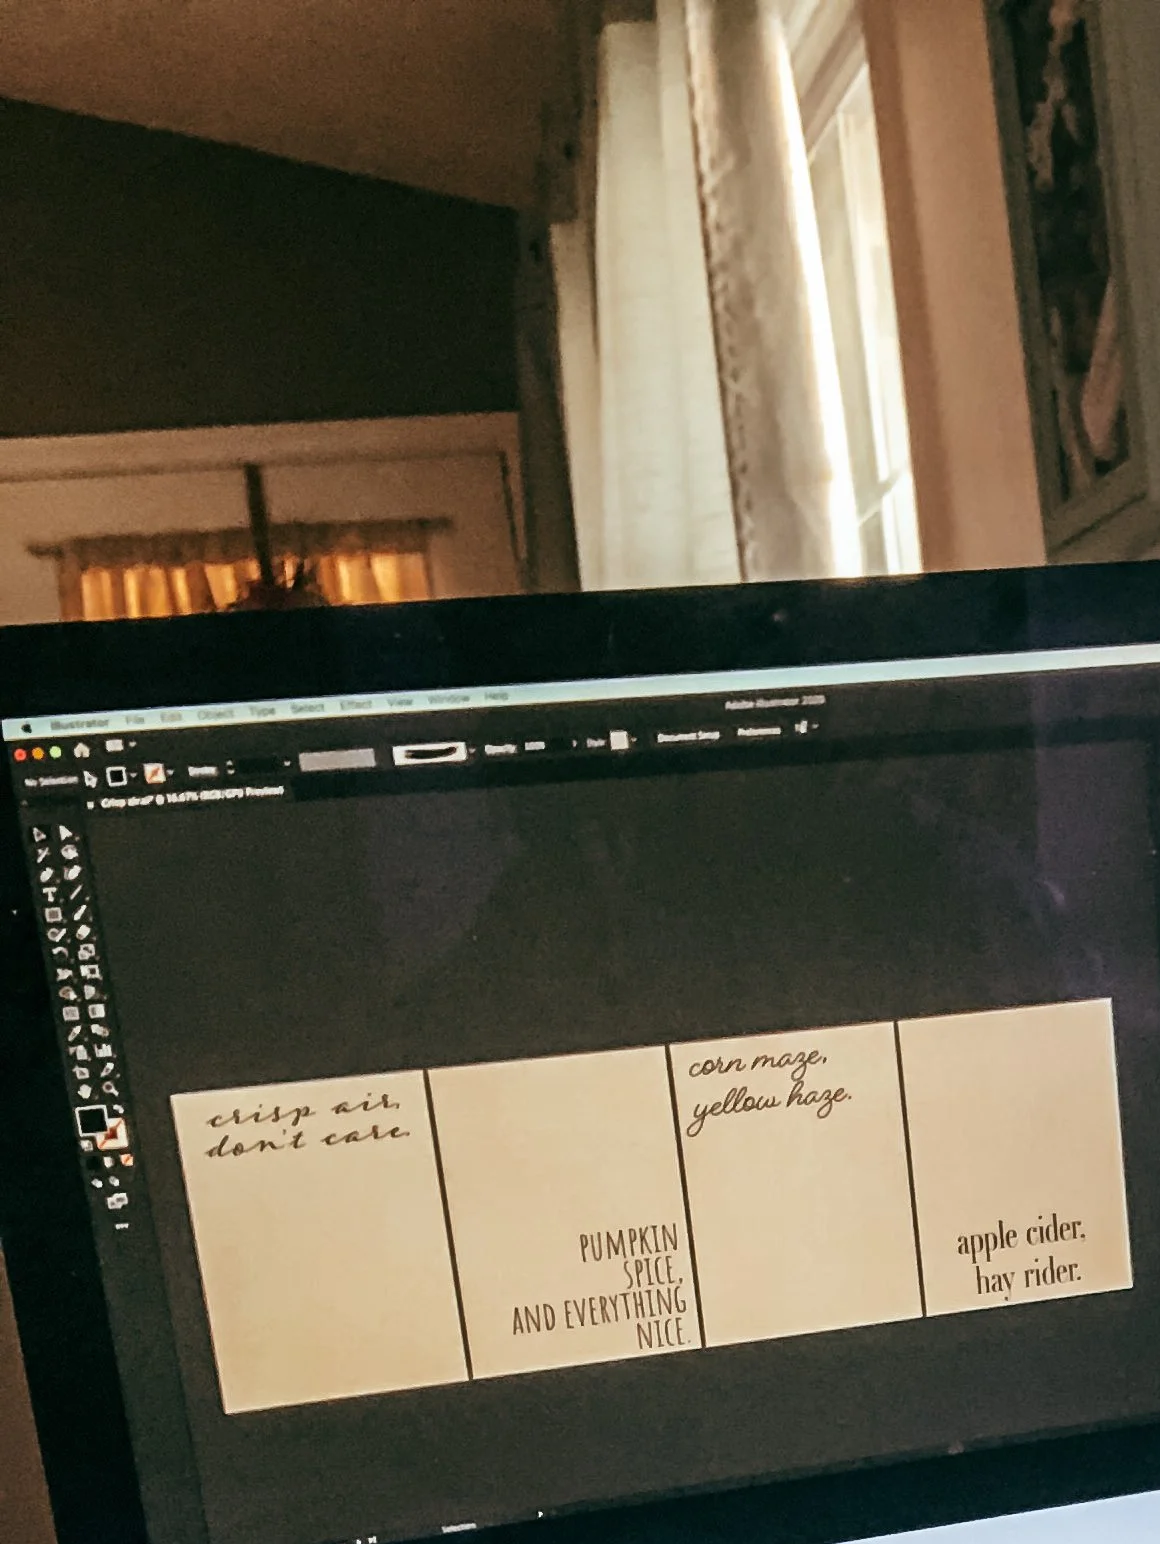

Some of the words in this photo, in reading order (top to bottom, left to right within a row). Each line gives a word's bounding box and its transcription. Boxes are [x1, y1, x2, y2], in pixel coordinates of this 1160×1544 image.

[687, 1056, 748, 1079] corn
[206, 1103, 316, 1128] crisp
[685, 1085, 783, 1139] yellow
[205, 1128, 306, 1158] don't
[578, 1222, 679, 1263] PUMPKIN
[956, 1218, 1019, 1265] apple
[622, 1255, 684, 1290] SPICE,
[974, 1264, 1017, 1303] hay
[1023, 1254, 1083, 1289] rider.
[511, 1302, 557, 1336] AND
[563, 1285, 688, 1330] EVERYTHING
[635, 1316, 693, 1350] NICE.
